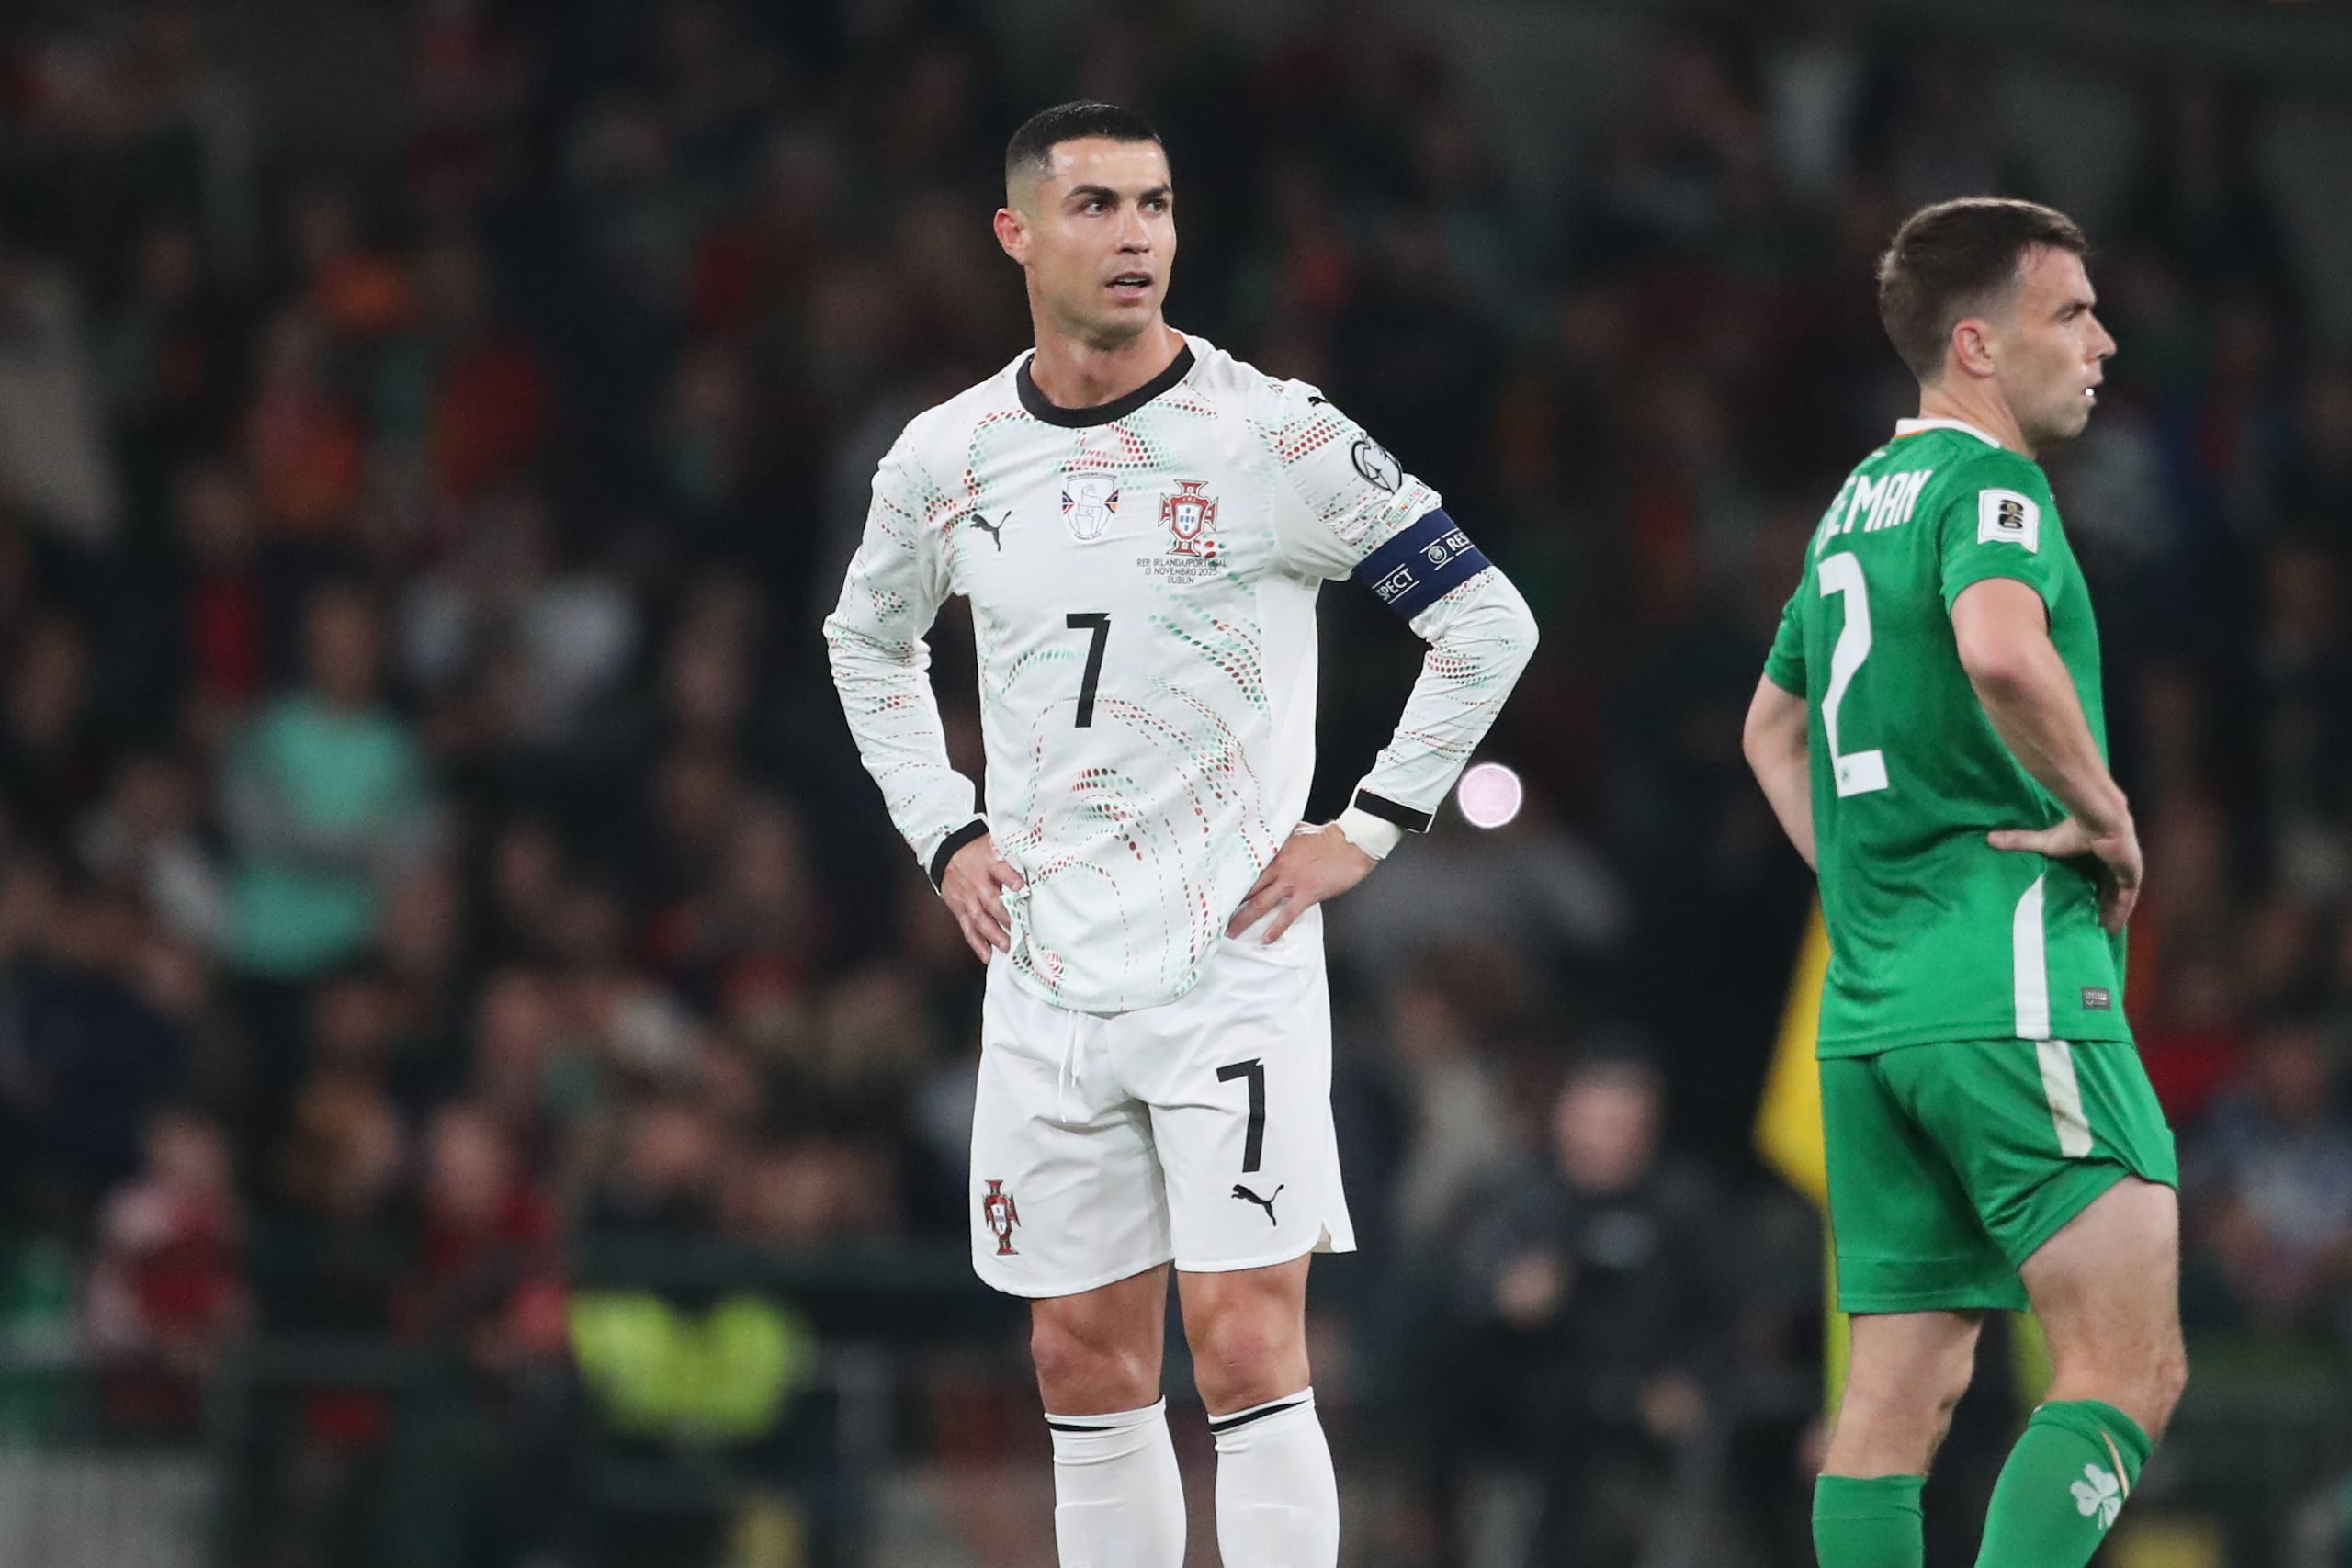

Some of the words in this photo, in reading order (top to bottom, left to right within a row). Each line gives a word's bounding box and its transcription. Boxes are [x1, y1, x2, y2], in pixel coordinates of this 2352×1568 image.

[1153, 558, 1227, 568] IRLANDA/PORTAL
[1167, 576, 1195, 585] DUBLIN
[1066, 613, 1111, 728] 7
[1817, 551, 1889, 798] 2
[1216, 1057, 1265, 1173] 7
